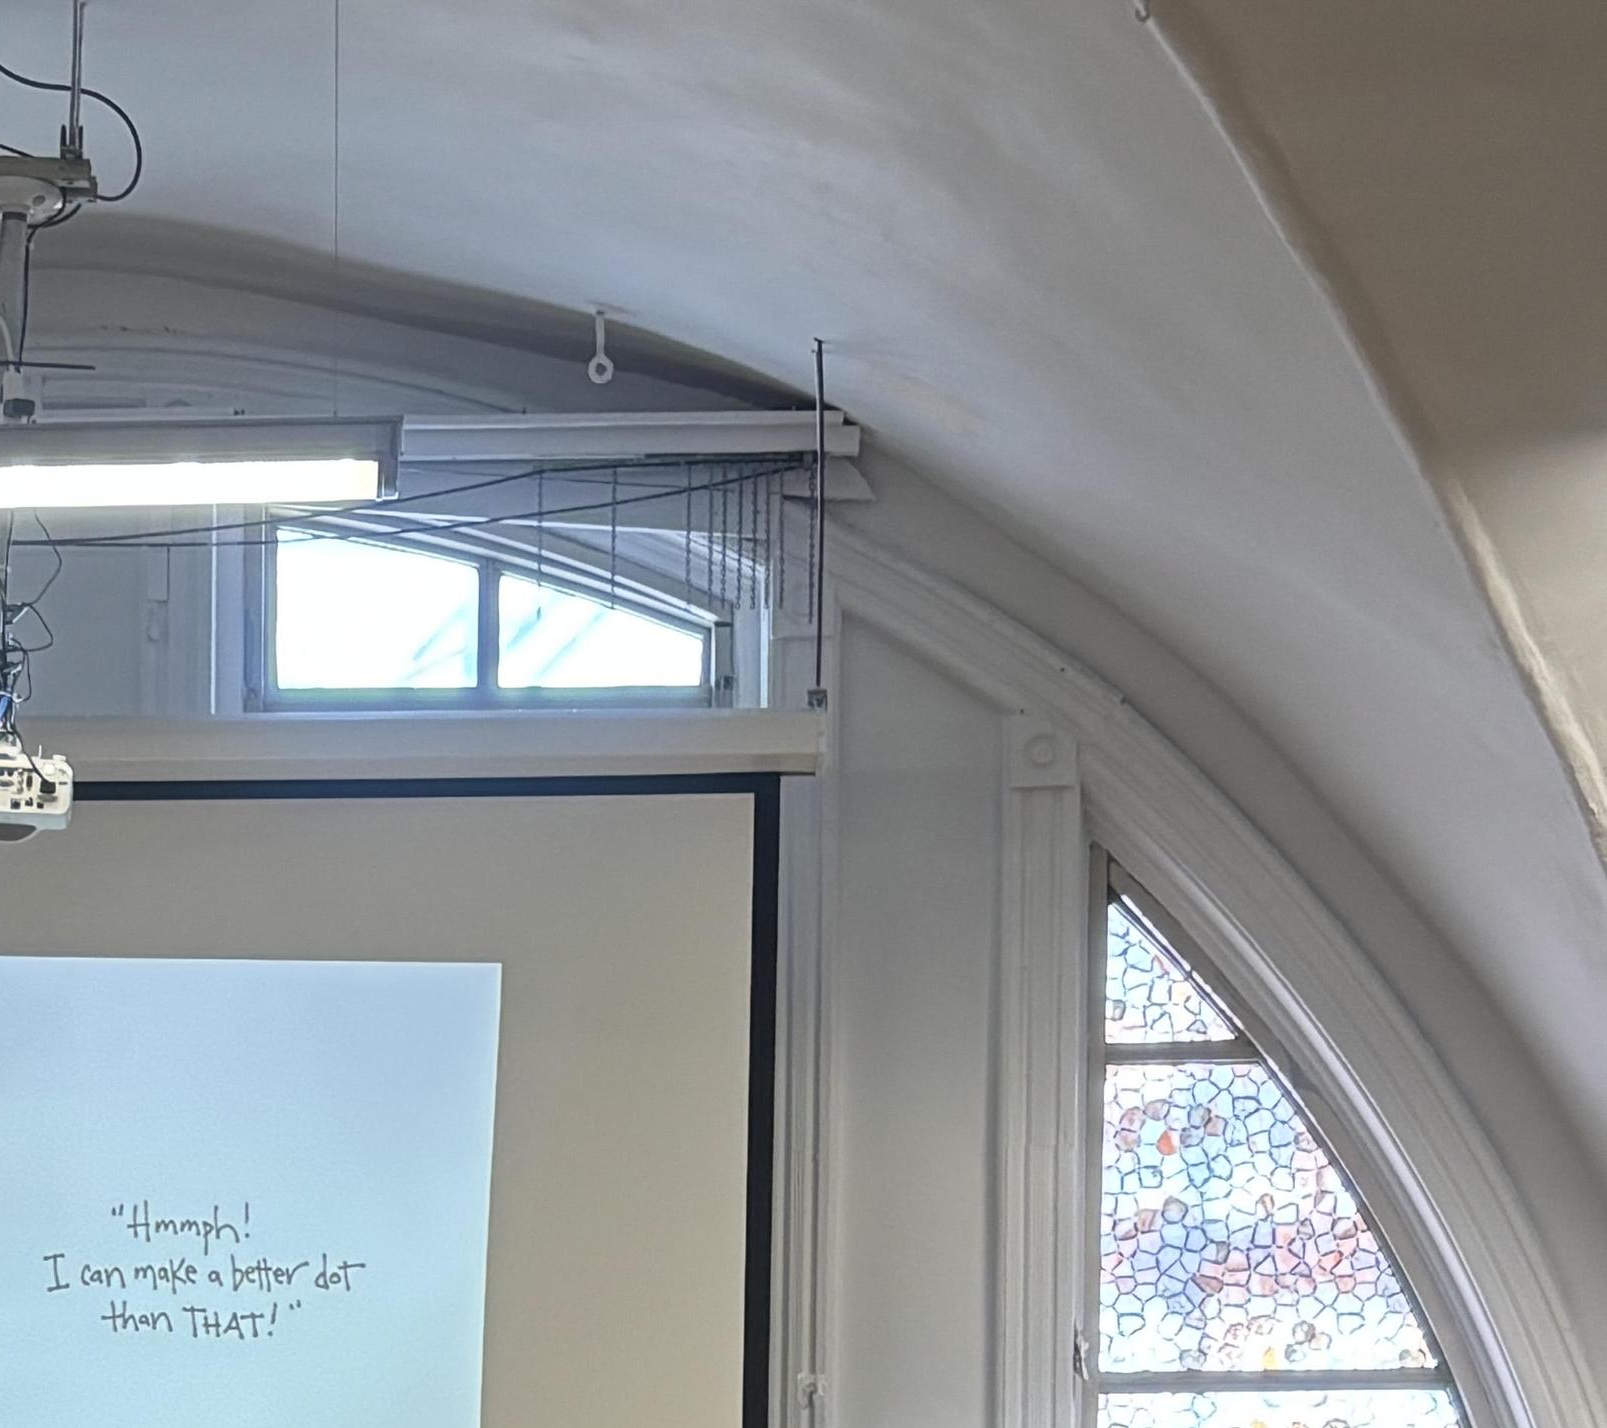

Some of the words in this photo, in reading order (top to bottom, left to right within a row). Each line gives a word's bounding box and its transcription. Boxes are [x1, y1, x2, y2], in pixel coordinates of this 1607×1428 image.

[43, 1253, 70, 1292] I
[80, 1263, 127, 1289] can
[134, 1257, 198, 1294] make
[208, 1270, 224, 1287] a
[230, 1253, 310, 1292] better
[314, 1253, 367, 1291] dot
[101, 1300, 173, 1332] than
